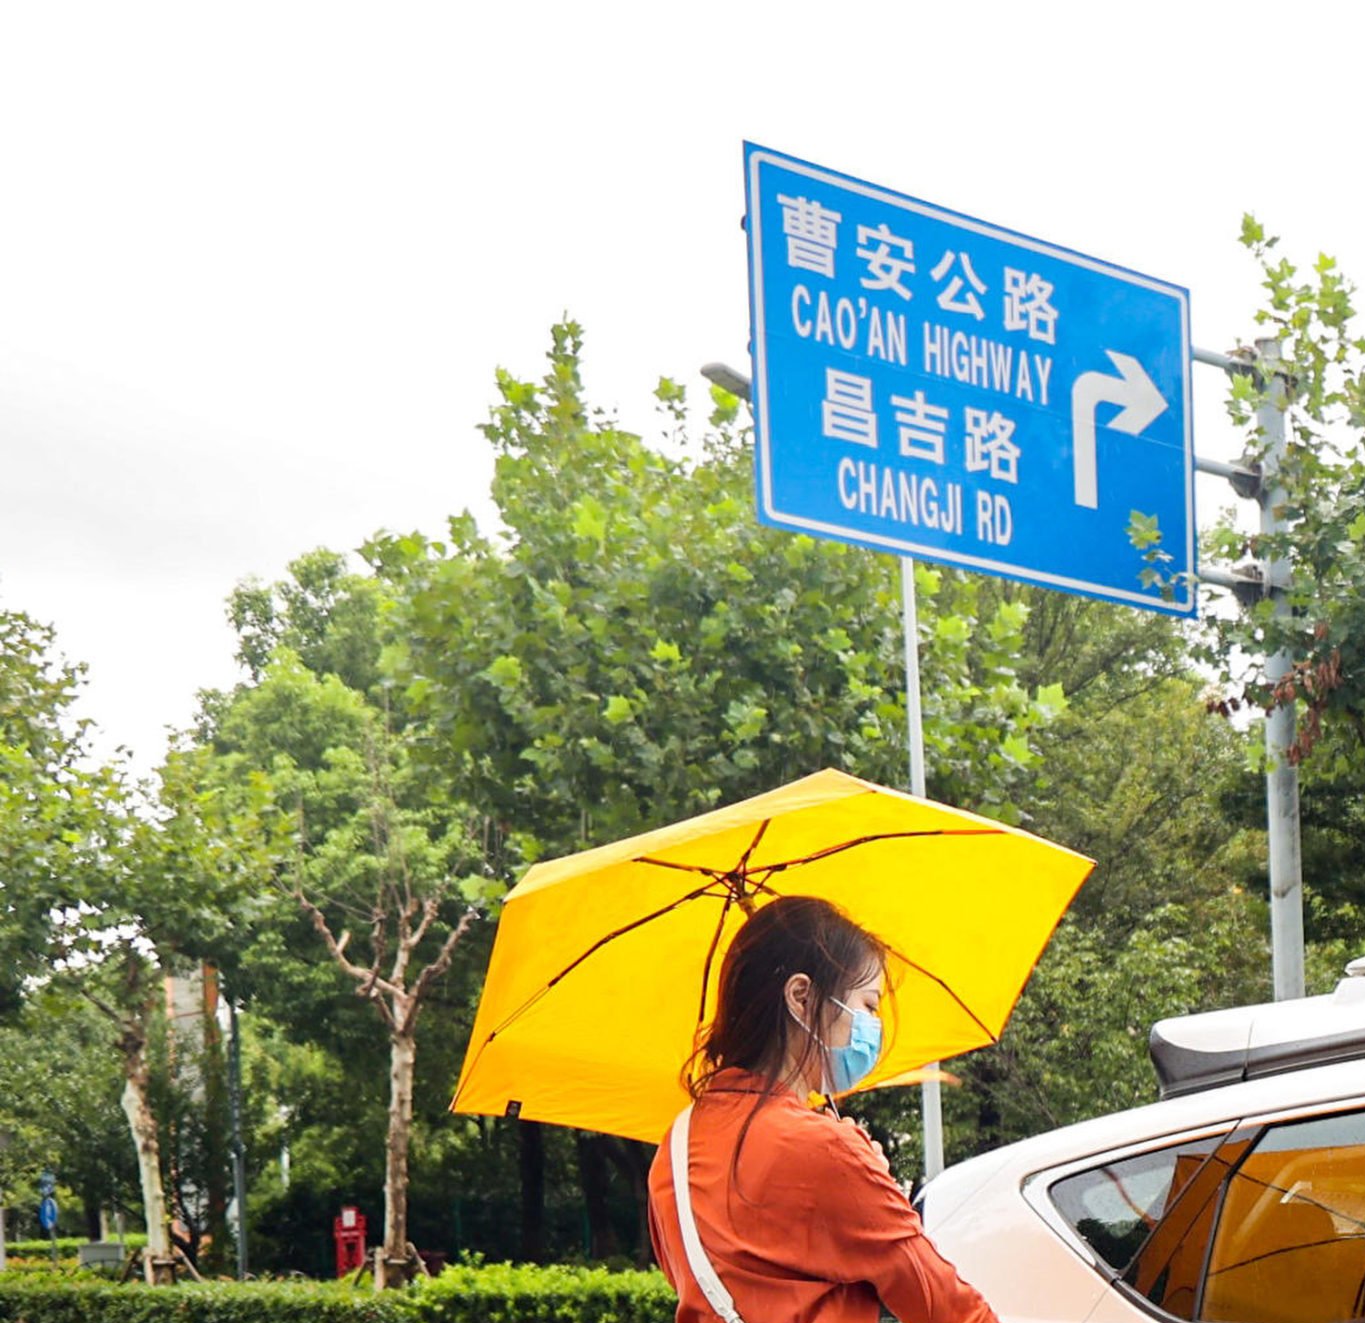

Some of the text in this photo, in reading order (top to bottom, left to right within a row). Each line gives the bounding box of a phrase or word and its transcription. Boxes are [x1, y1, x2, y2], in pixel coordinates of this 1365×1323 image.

[776, 193, 1059, 345] 曹安公路
[923, 321, 1053, 405] HIGHWAY
[821, 367, 1021, 484] 昌吉路
[837, 457, 1013, 547] CHANGJI RD
